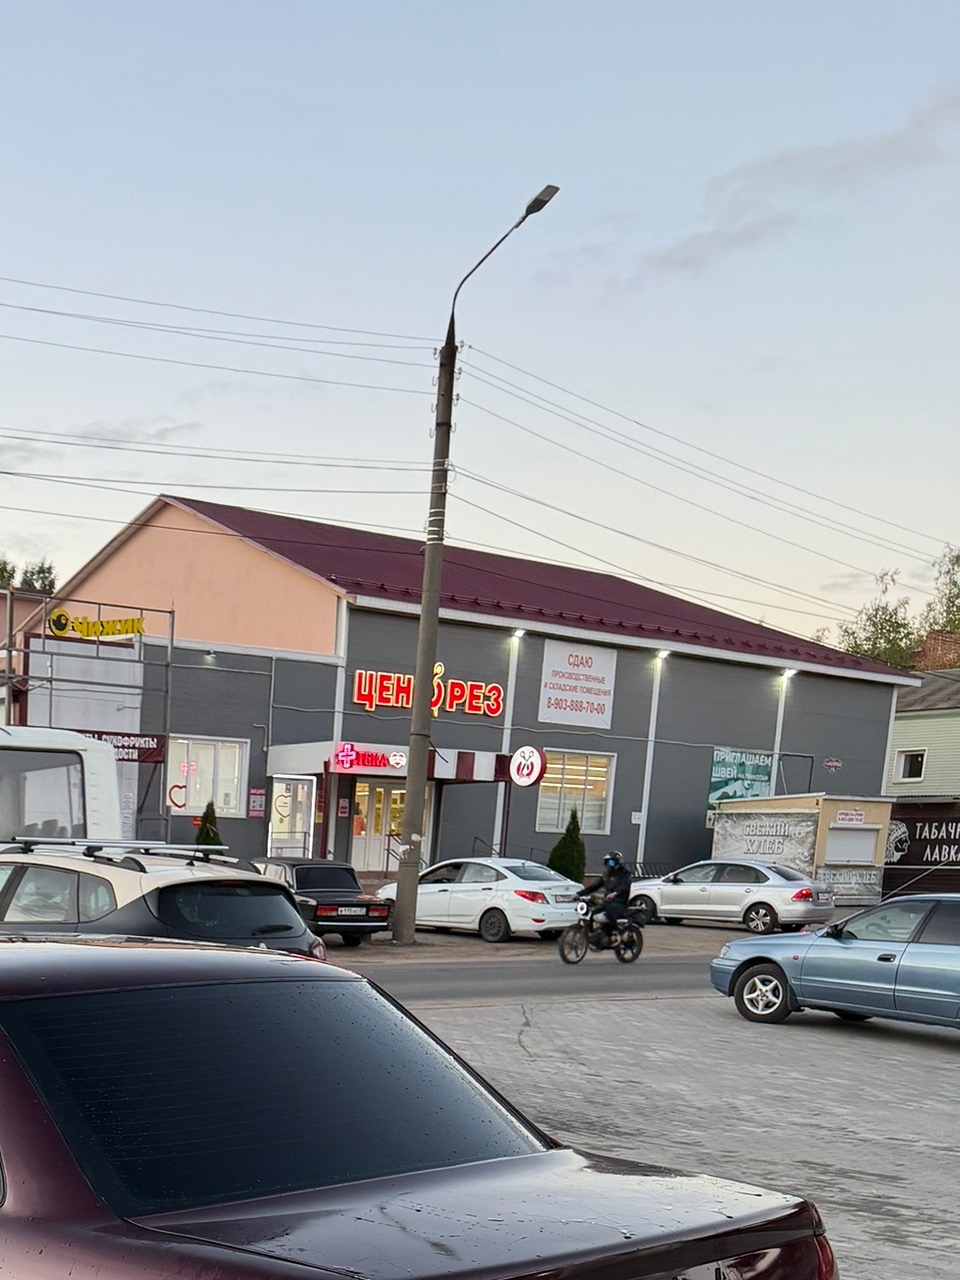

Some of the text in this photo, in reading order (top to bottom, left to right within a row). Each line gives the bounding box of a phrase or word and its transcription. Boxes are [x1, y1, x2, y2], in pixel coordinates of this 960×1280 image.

[567, 653, 593, 669] СДАЮ
[551, 669, 607, 684] ПРОИЗВОДСТВЕННЫЕ
[579, 685, 612, 697] ПОМЕЩЕНИЯ
[546, 696, 606, 715] 8-903-888-70-00
[714, 750, 772, 767] ПРИГЛАШАЕМ
[712, 766, 737, 779] ШВЕЙ
[742, 820, 790, 837] СВЕЖИЙ
[743, 838, 785, 855] ХЛЕБ
